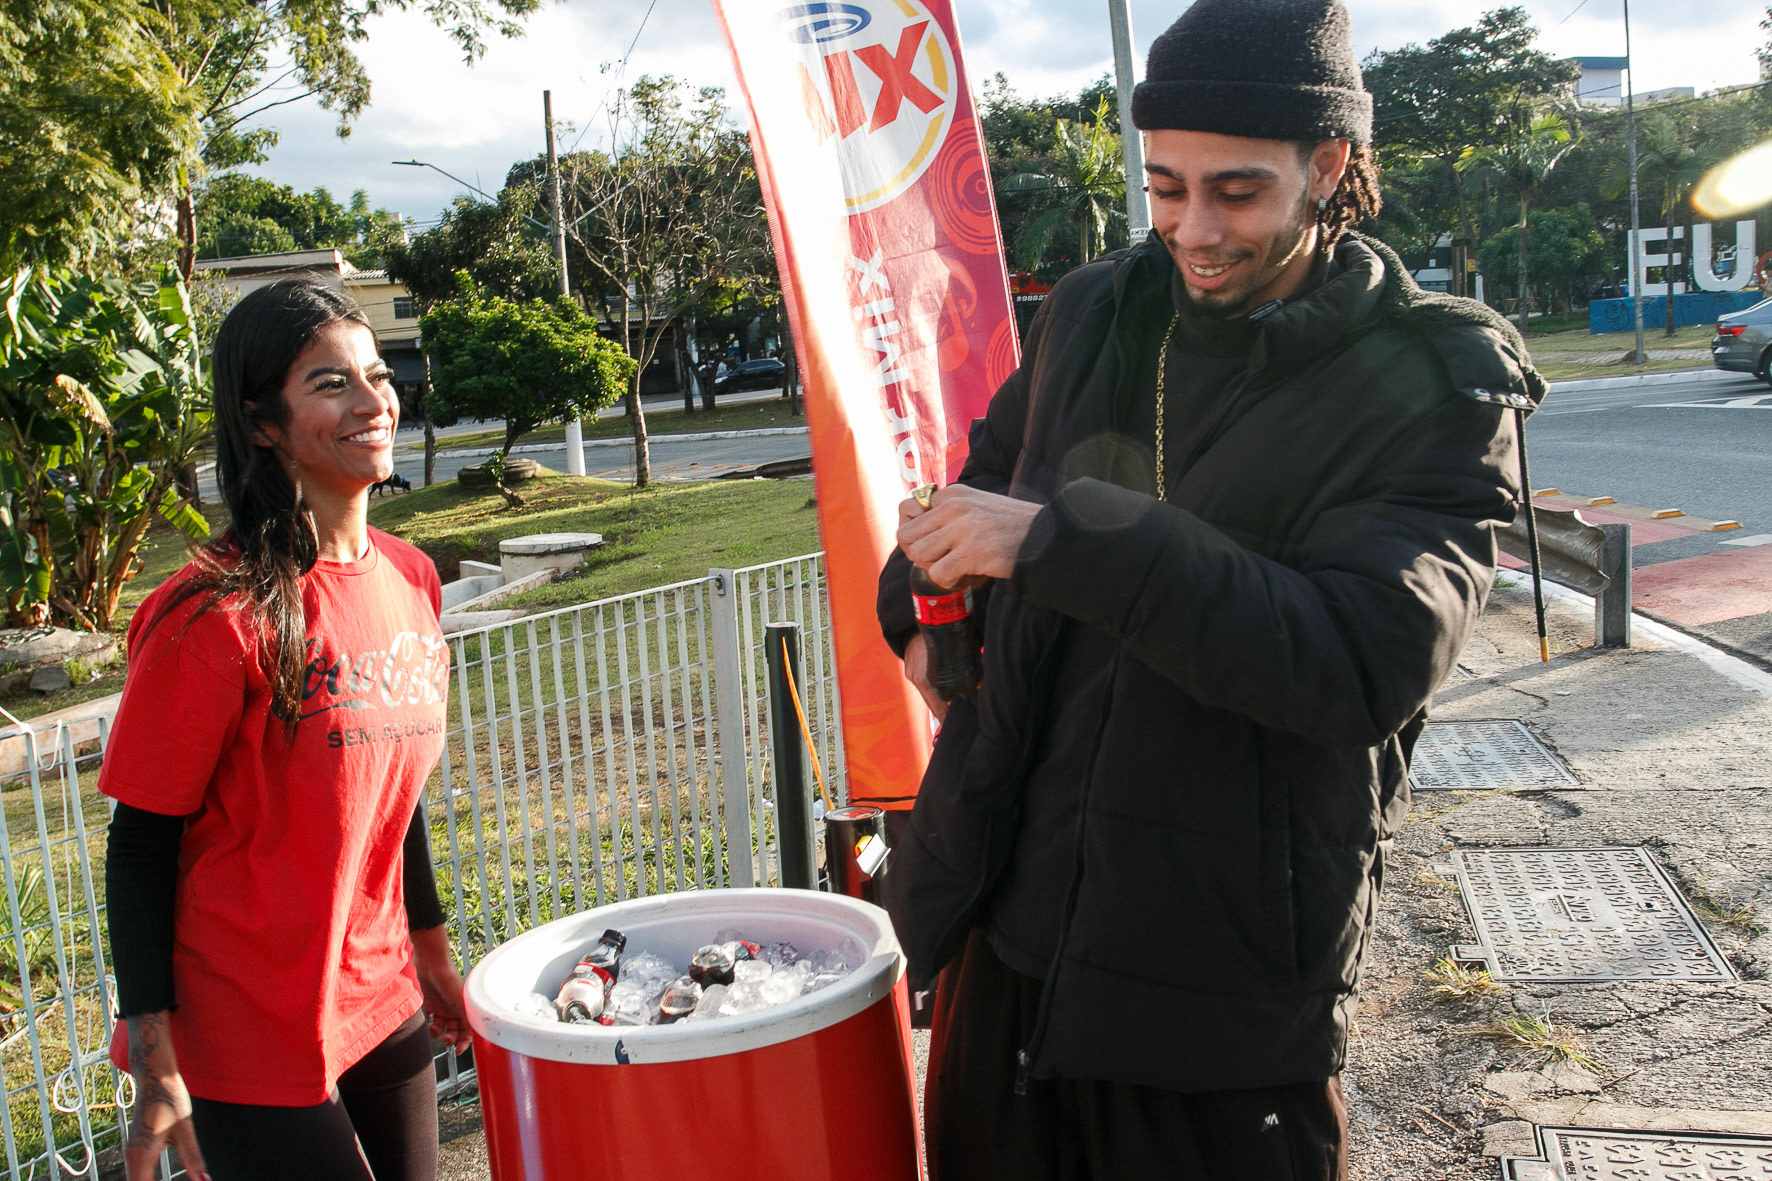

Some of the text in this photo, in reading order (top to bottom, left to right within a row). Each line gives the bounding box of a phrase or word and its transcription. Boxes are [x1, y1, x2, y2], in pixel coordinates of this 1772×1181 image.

[798, 20, 946, 146] IX
[1627, 219, 1757, 297] EU
[327, 727, 376, 749] SEM
